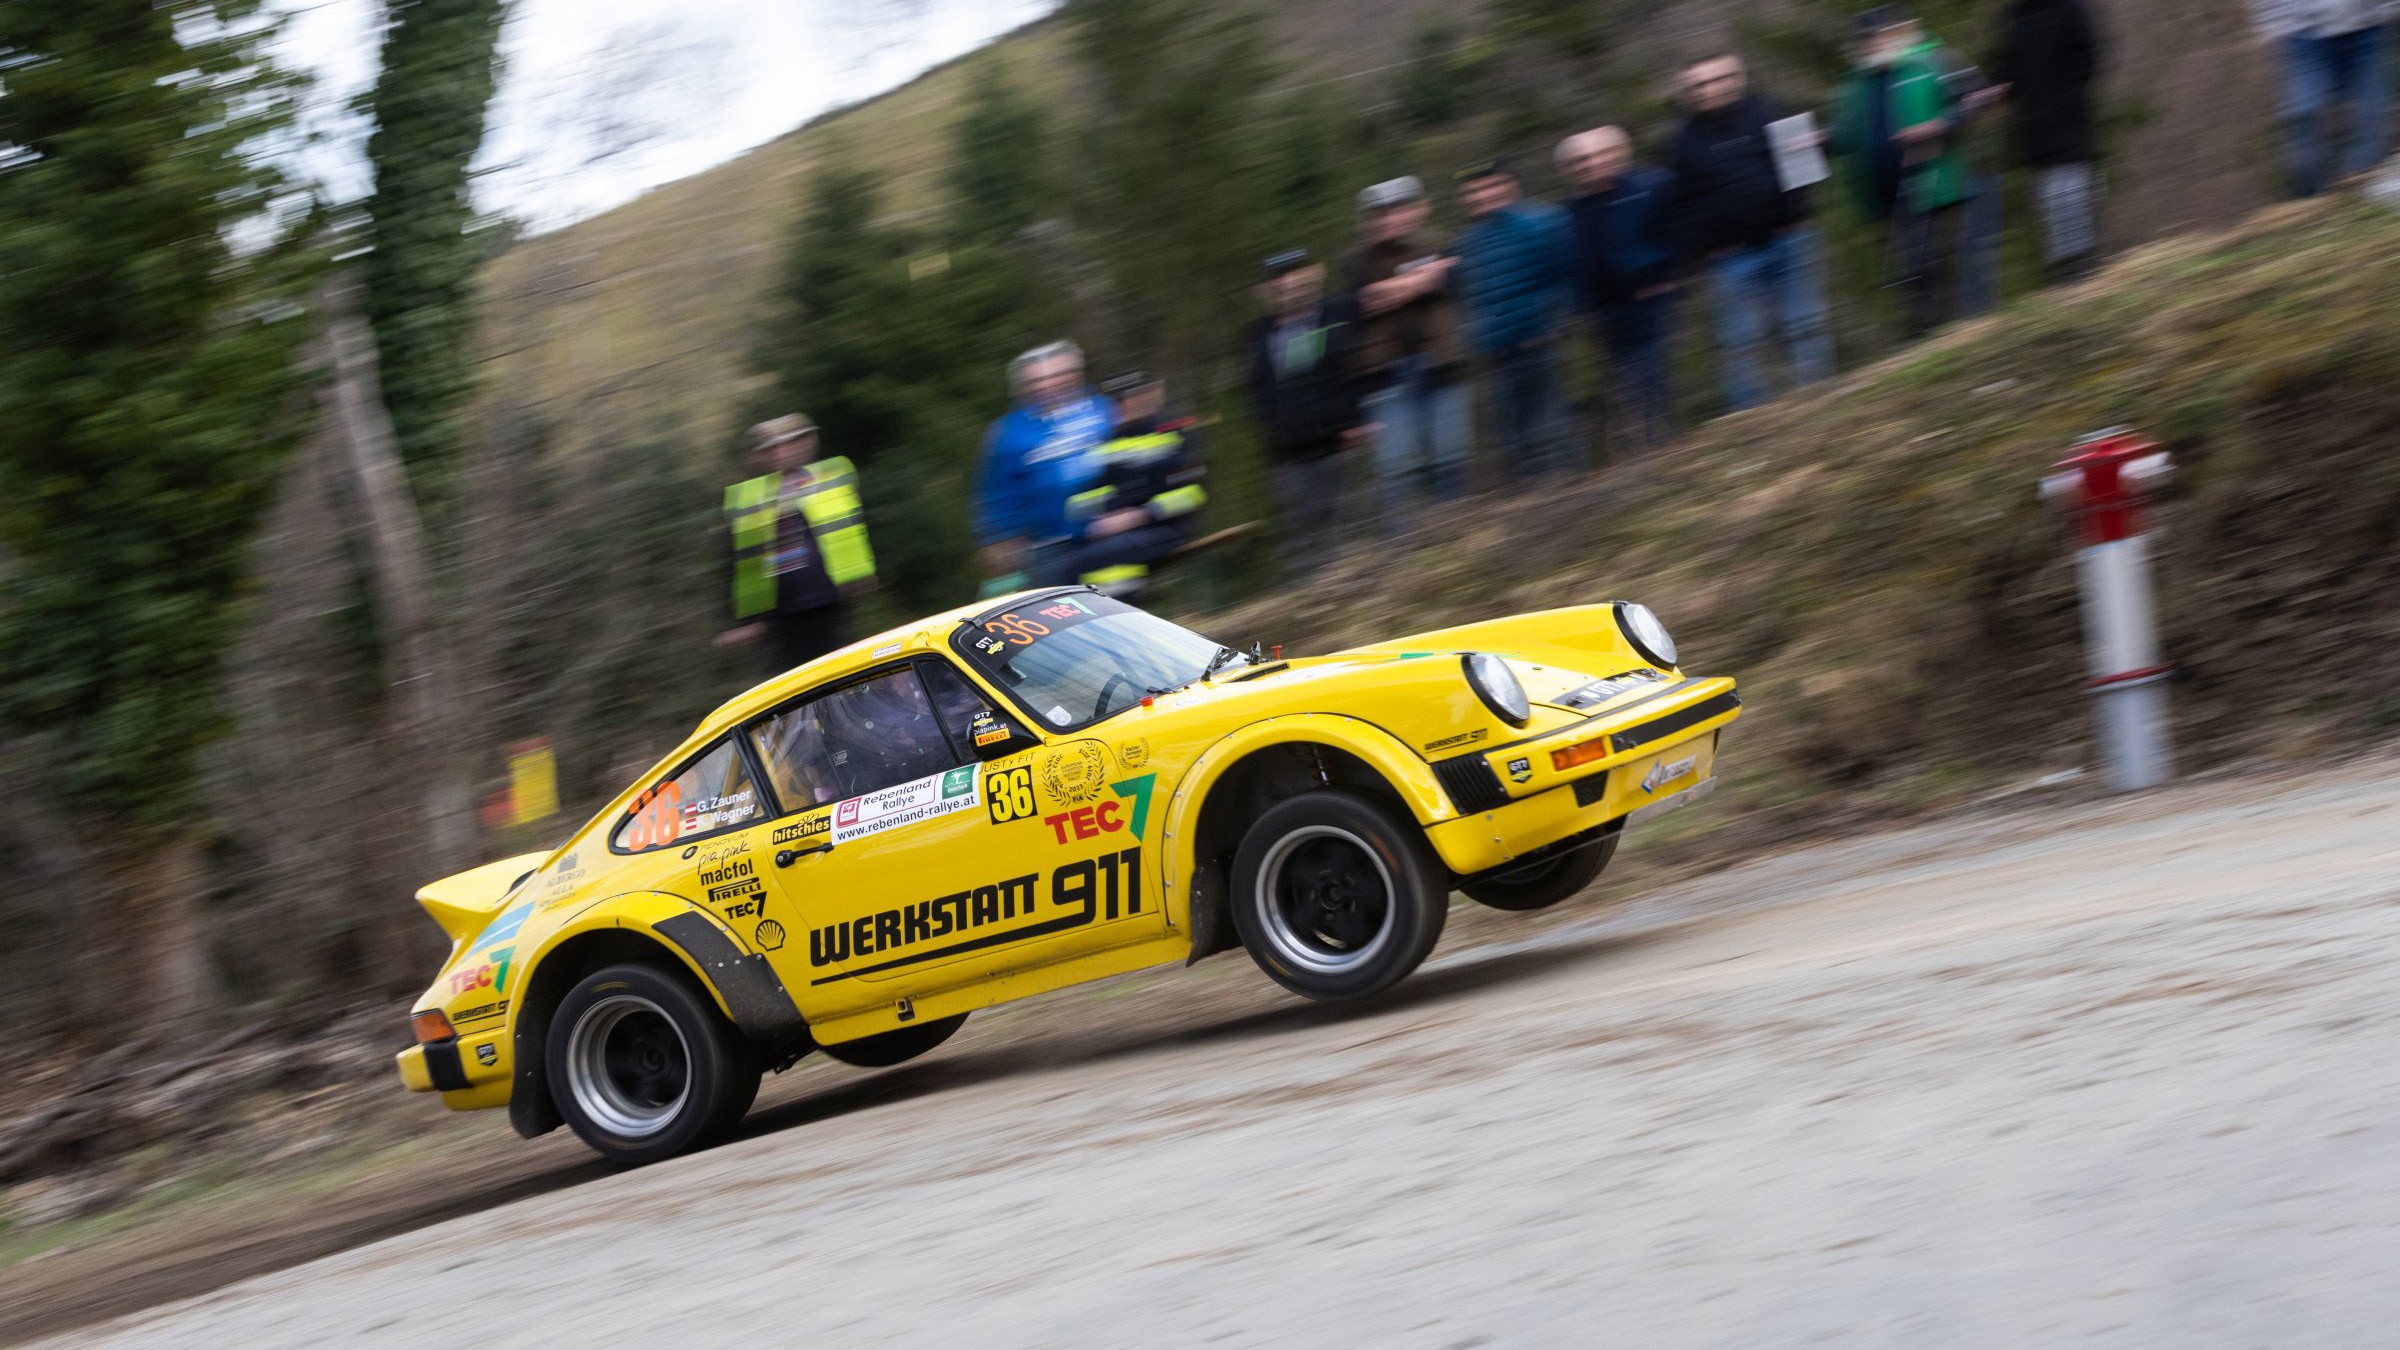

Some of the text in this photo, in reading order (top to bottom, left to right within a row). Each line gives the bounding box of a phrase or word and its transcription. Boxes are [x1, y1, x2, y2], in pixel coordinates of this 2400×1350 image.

[1038, 597, 1098, 620] TEC7
[984, 613, 1050, 645] 36
[1018, 751, 1037, 764] FIT
[711, 790, 752, 808] Zauner
[863, 779, 932, 806] Rebenland
[882, 794, 915, 811] Rallye
[988, 768, 1034, 822] 36
[628, 781, 681, 851] 36
[711, 803, 755, 824] Wagner
[837, 794, 976, 841] www.rebenland-rallye.at
[1043, 772, 1158, 845] TEC7
[773, 819, 830, 843] hitschies
[700, 858, 754, 886] macfol
[707, 877, 762, 903] PIRELLI
[724, 891, 768, 920] TEC7
[809, 846, 1142, 968] WERKSTATT 911
[450, 945, 517, 996] TEC7
